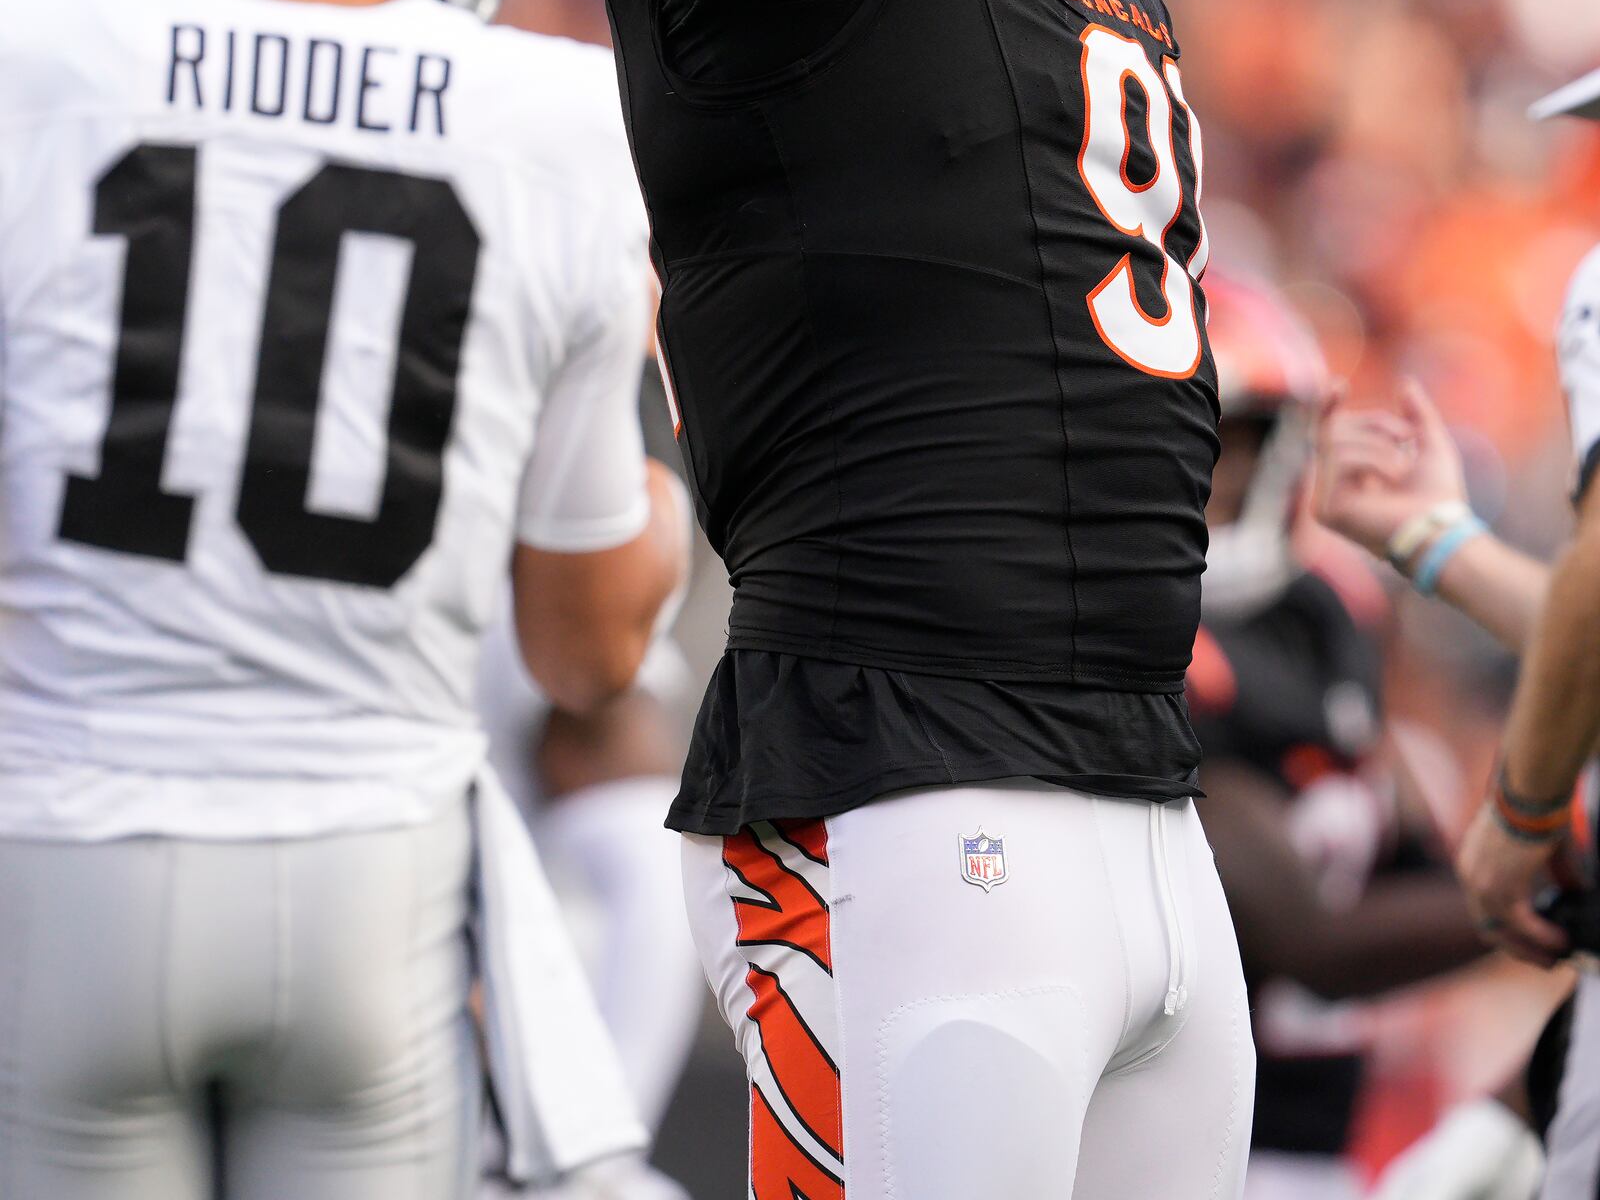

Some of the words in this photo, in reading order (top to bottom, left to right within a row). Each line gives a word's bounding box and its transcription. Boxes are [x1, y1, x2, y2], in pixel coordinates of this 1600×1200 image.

[166, 23, 453, 136] RIDDER
[57, 139, 482, 590] 10
[969, 855, 1002, 879] NFL
